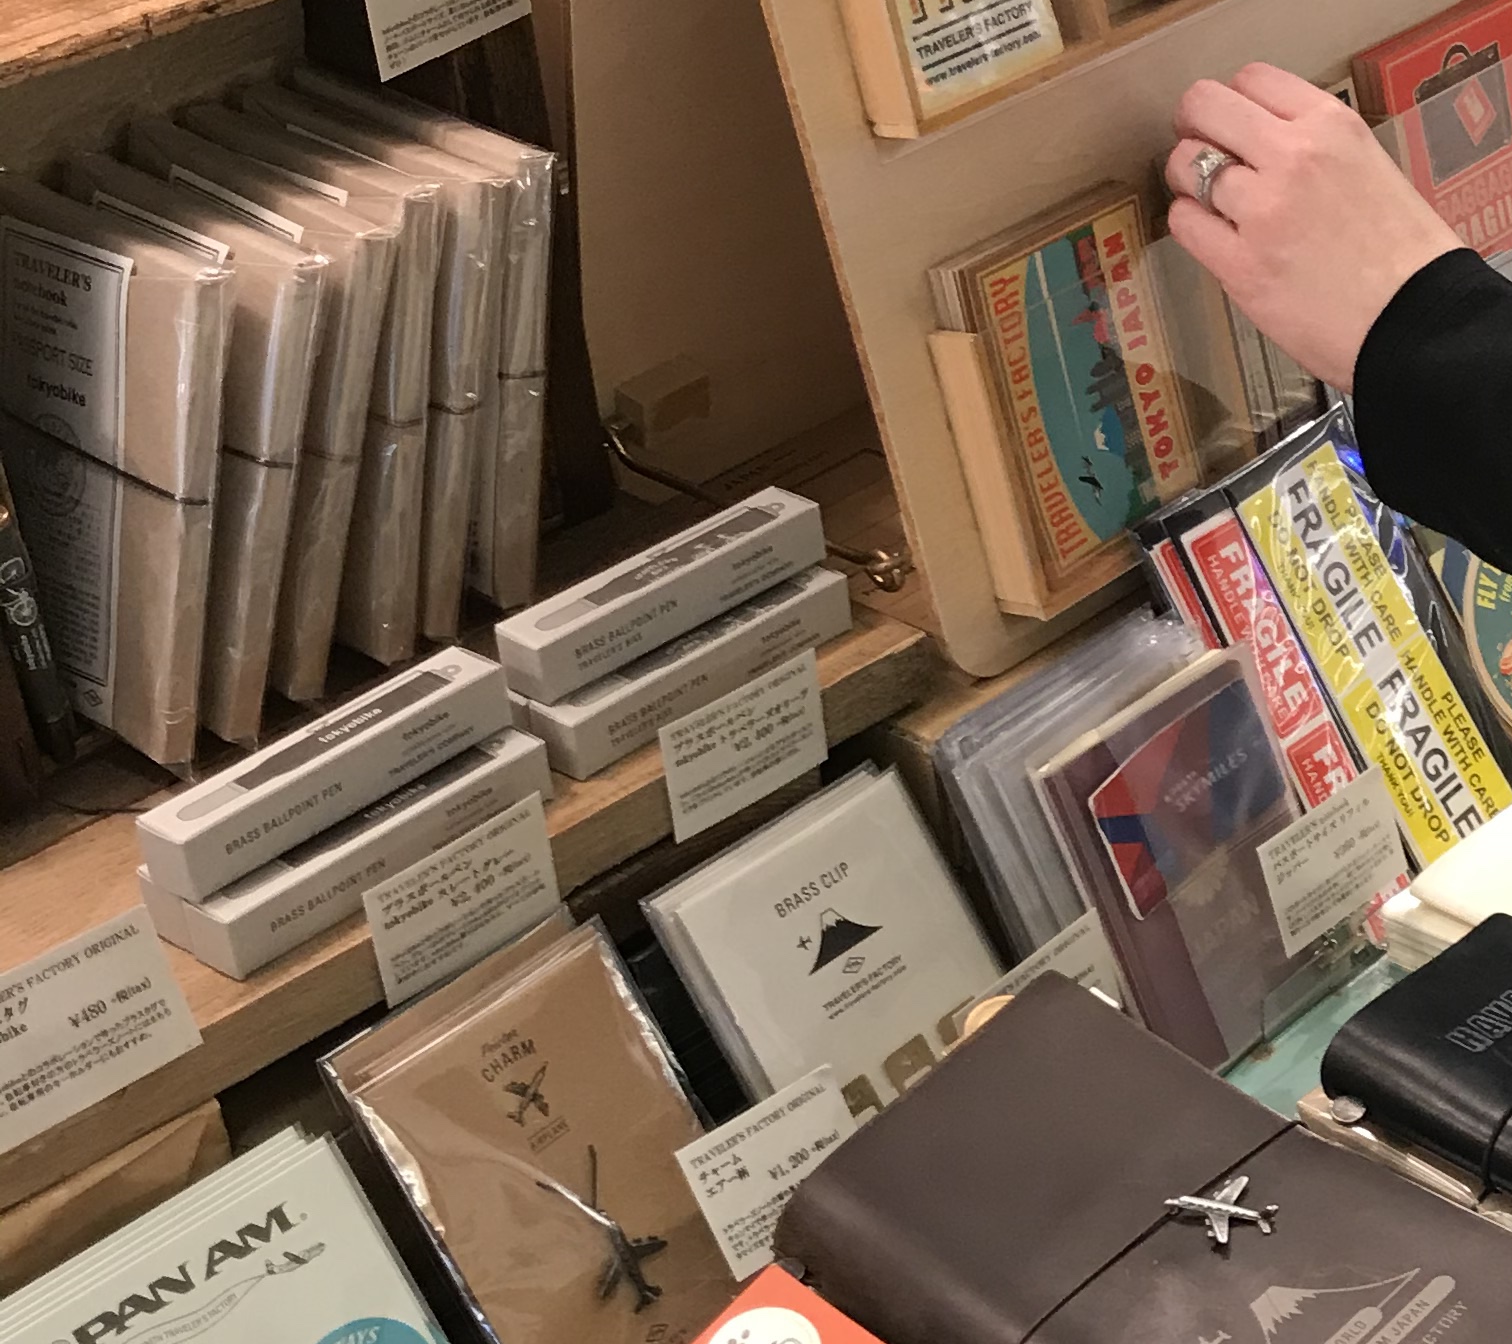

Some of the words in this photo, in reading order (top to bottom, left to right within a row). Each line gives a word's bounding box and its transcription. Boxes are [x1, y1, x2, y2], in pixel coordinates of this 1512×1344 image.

[982, 0, 1035, 37] FACTORY
[1104, 231, 1149, 352] JAPAN
[990, 271, 1031, 398] FACTORY
[26, 372, 87, 408] tokyobike
[1135, 361, 1180, 481] TOKYO
[1018, 404, 1088, 559] TRAVELER'S
[1207, 554, 1243, 627] HANDLE
[1286, 544, 1319, 601] NOT
[1311, 597, 1352, 660] DROP
[1287, 477, 1386, 658] FRAGILE
[1343, 539, 1373, 593] WITH
[1370, 587, 1402, 644] CARE
[574, 633, 606, 659] BRASS
[659, 598, 680, 617] PEN
[1220, 540, 1312, 718] FRAGILE
[317, 706, 384, 744] tokyobike
[1376, 665, 1488, 840] FRAGILE
[1399, 649, 1446, 724] HANDLE
[1442, 722, 1474, 776] WITH
[1469, 771, 1499, 821] CARE
[1442, 691, 1486, 764] PLEASE
[1365, 699, 1393, 742] DO
[1386, 738, 1420, 793] NOT
[1410, 783, 1453, 847] DROP
[225, 824, 261, 856] BRASS
[263, 794, 322, 835] BALLPOINT
[321, 780, 344, 799] PEN
[270, 903, 305, 934] BRASS
[306, 869, 367, 913] BALLPOINT
[366, 857, 388, 878] PEN
[773, 884, 822, 920] BRASS
[819, 860, 852, 891] CLIP
[26, 952, 82, 990] FACTORY
[83, 923, 141, 960] ORIGINAL
[67, 999, 108, 1030] ¥480
[481, 1038, 538, 1084] CHARM
[204, 1200, 301, 1282] AM
[1385, 1299, 1432, 1342] JAPAN
